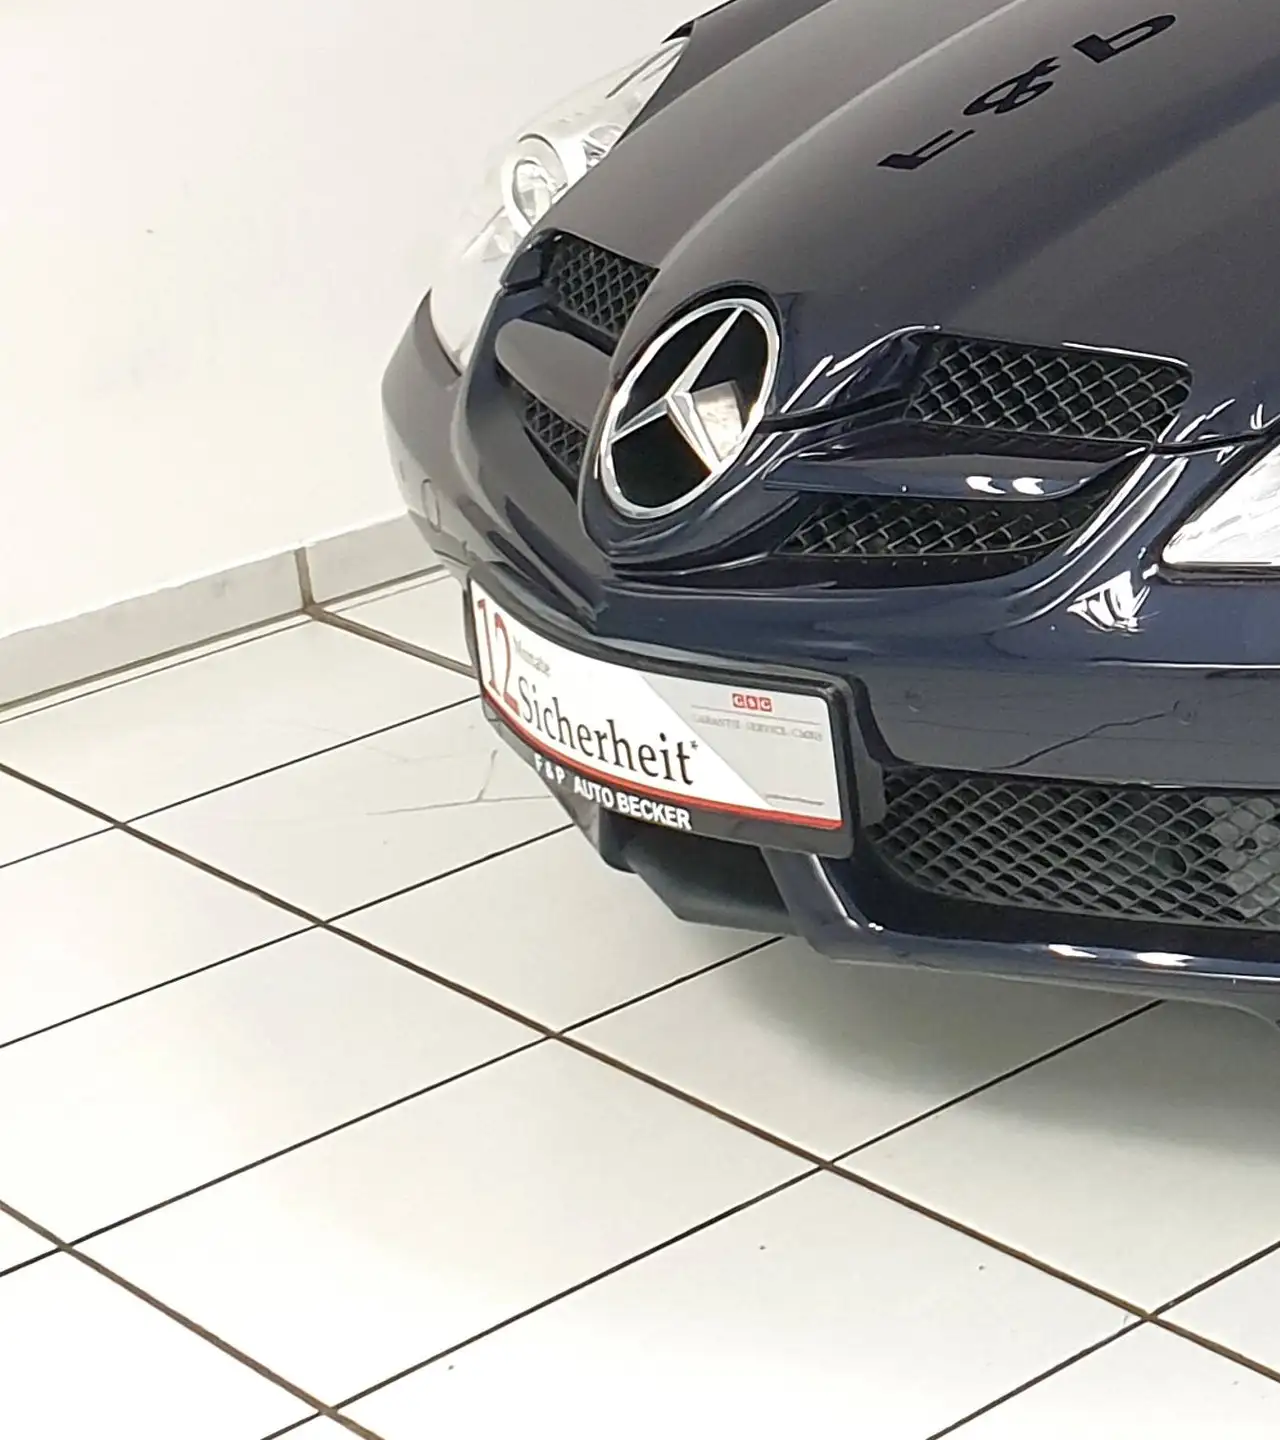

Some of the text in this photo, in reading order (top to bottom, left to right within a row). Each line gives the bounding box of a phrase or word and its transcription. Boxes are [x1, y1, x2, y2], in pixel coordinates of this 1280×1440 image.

[477, 598, 520, 716] 12
[573, 777, 616, 807] AUTO
[617, 793, 693, 830] BECKER
